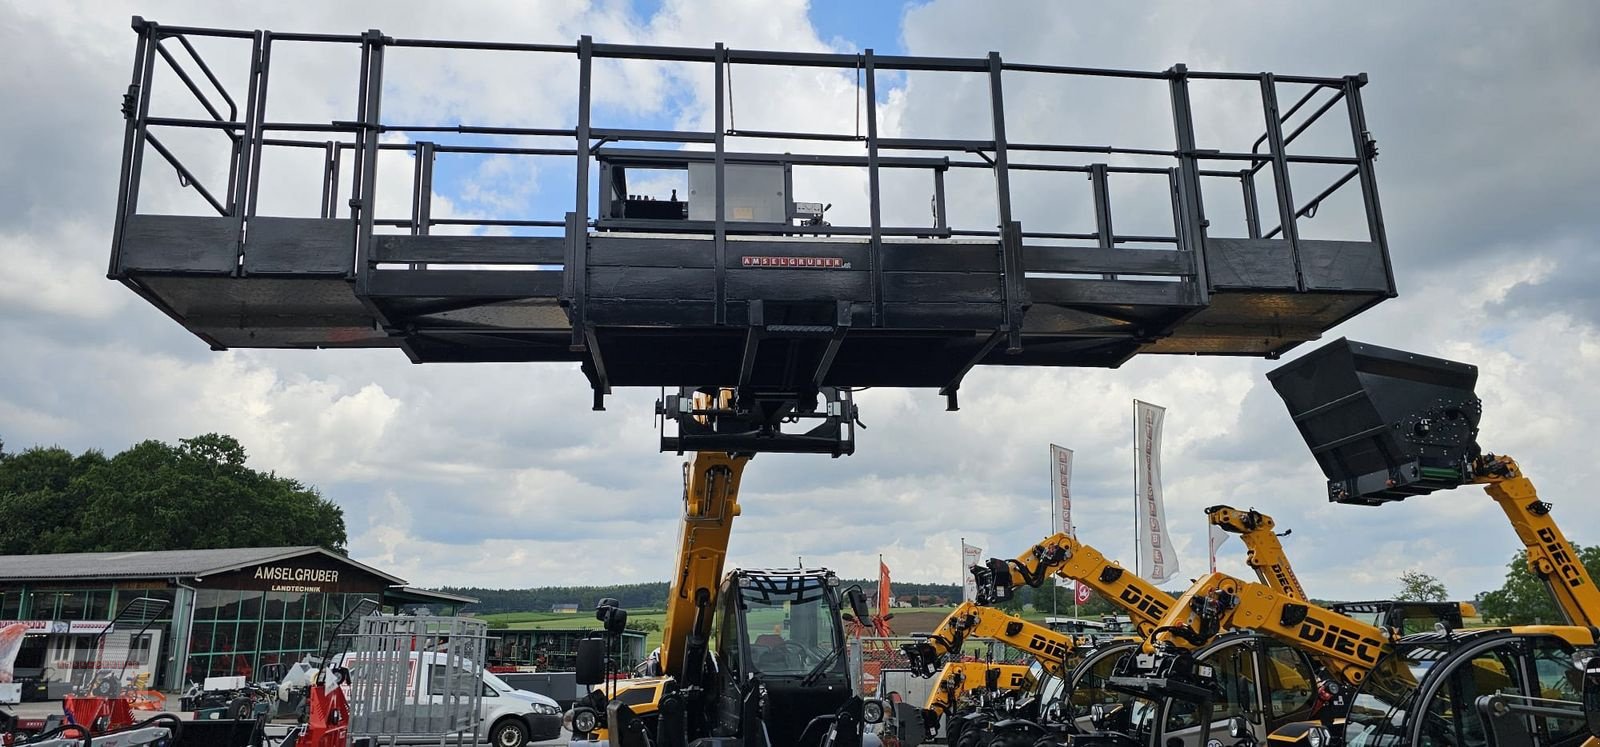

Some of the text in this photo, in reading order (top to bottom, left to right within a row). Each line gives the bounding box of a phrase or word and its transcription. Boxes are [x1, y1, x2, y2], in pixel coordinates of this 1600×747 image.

[743, 257, 843, 267] AMSELGRUBER
[1537, 527, 1585, 587] DIECI
[254, 566, 339, 582] AMSELGRUBER
[1271, 563, 1294, 595] DIEC
[1120, 583, 1169, 621] DIE
